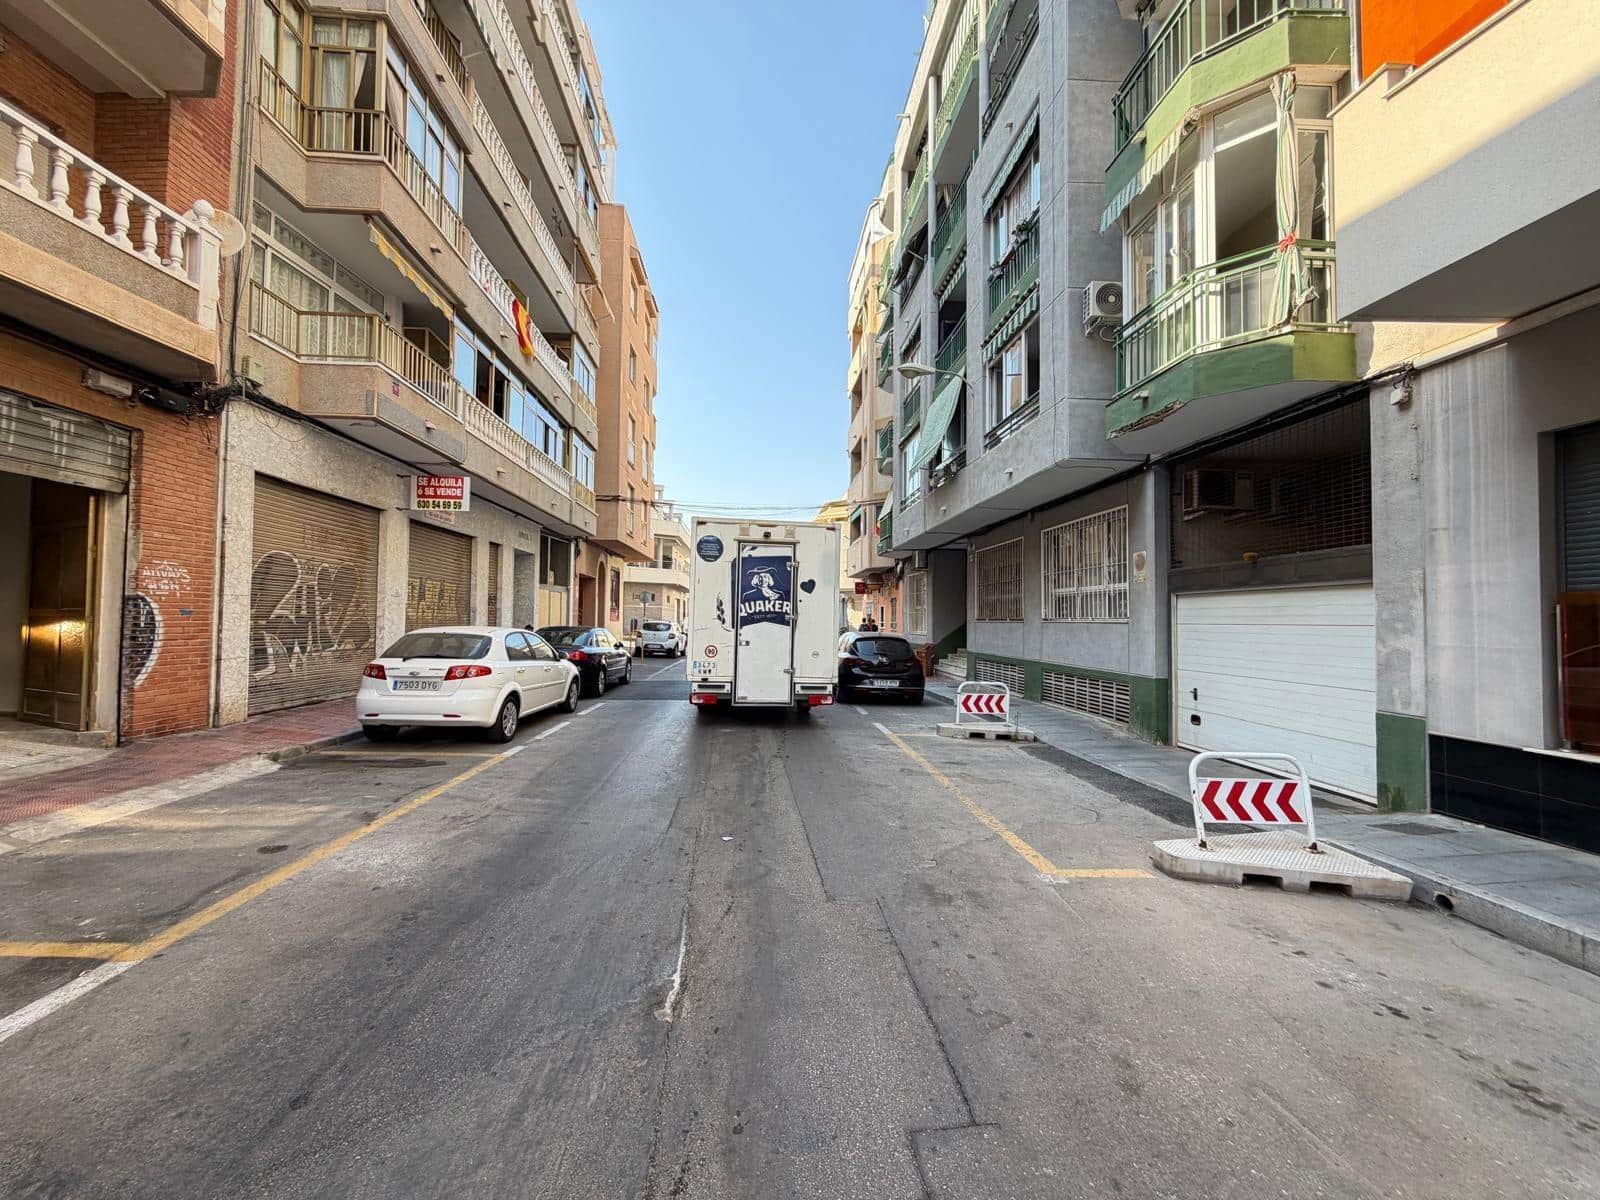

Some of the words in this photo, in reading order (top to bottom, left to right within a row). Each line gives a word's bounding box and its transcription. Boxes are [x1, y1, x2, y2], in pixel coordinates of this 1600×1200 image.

[418, 477, 428, 486] SE
[430, 478, 462, 487] ALQUILA
[424, 488, 435, 496] SE
[437, 488, 462, 497] VENDE
[417, 500, 430, 509] 630
[432, 501, 441, 509] 54
[399, 681, 419, 689] 7503
